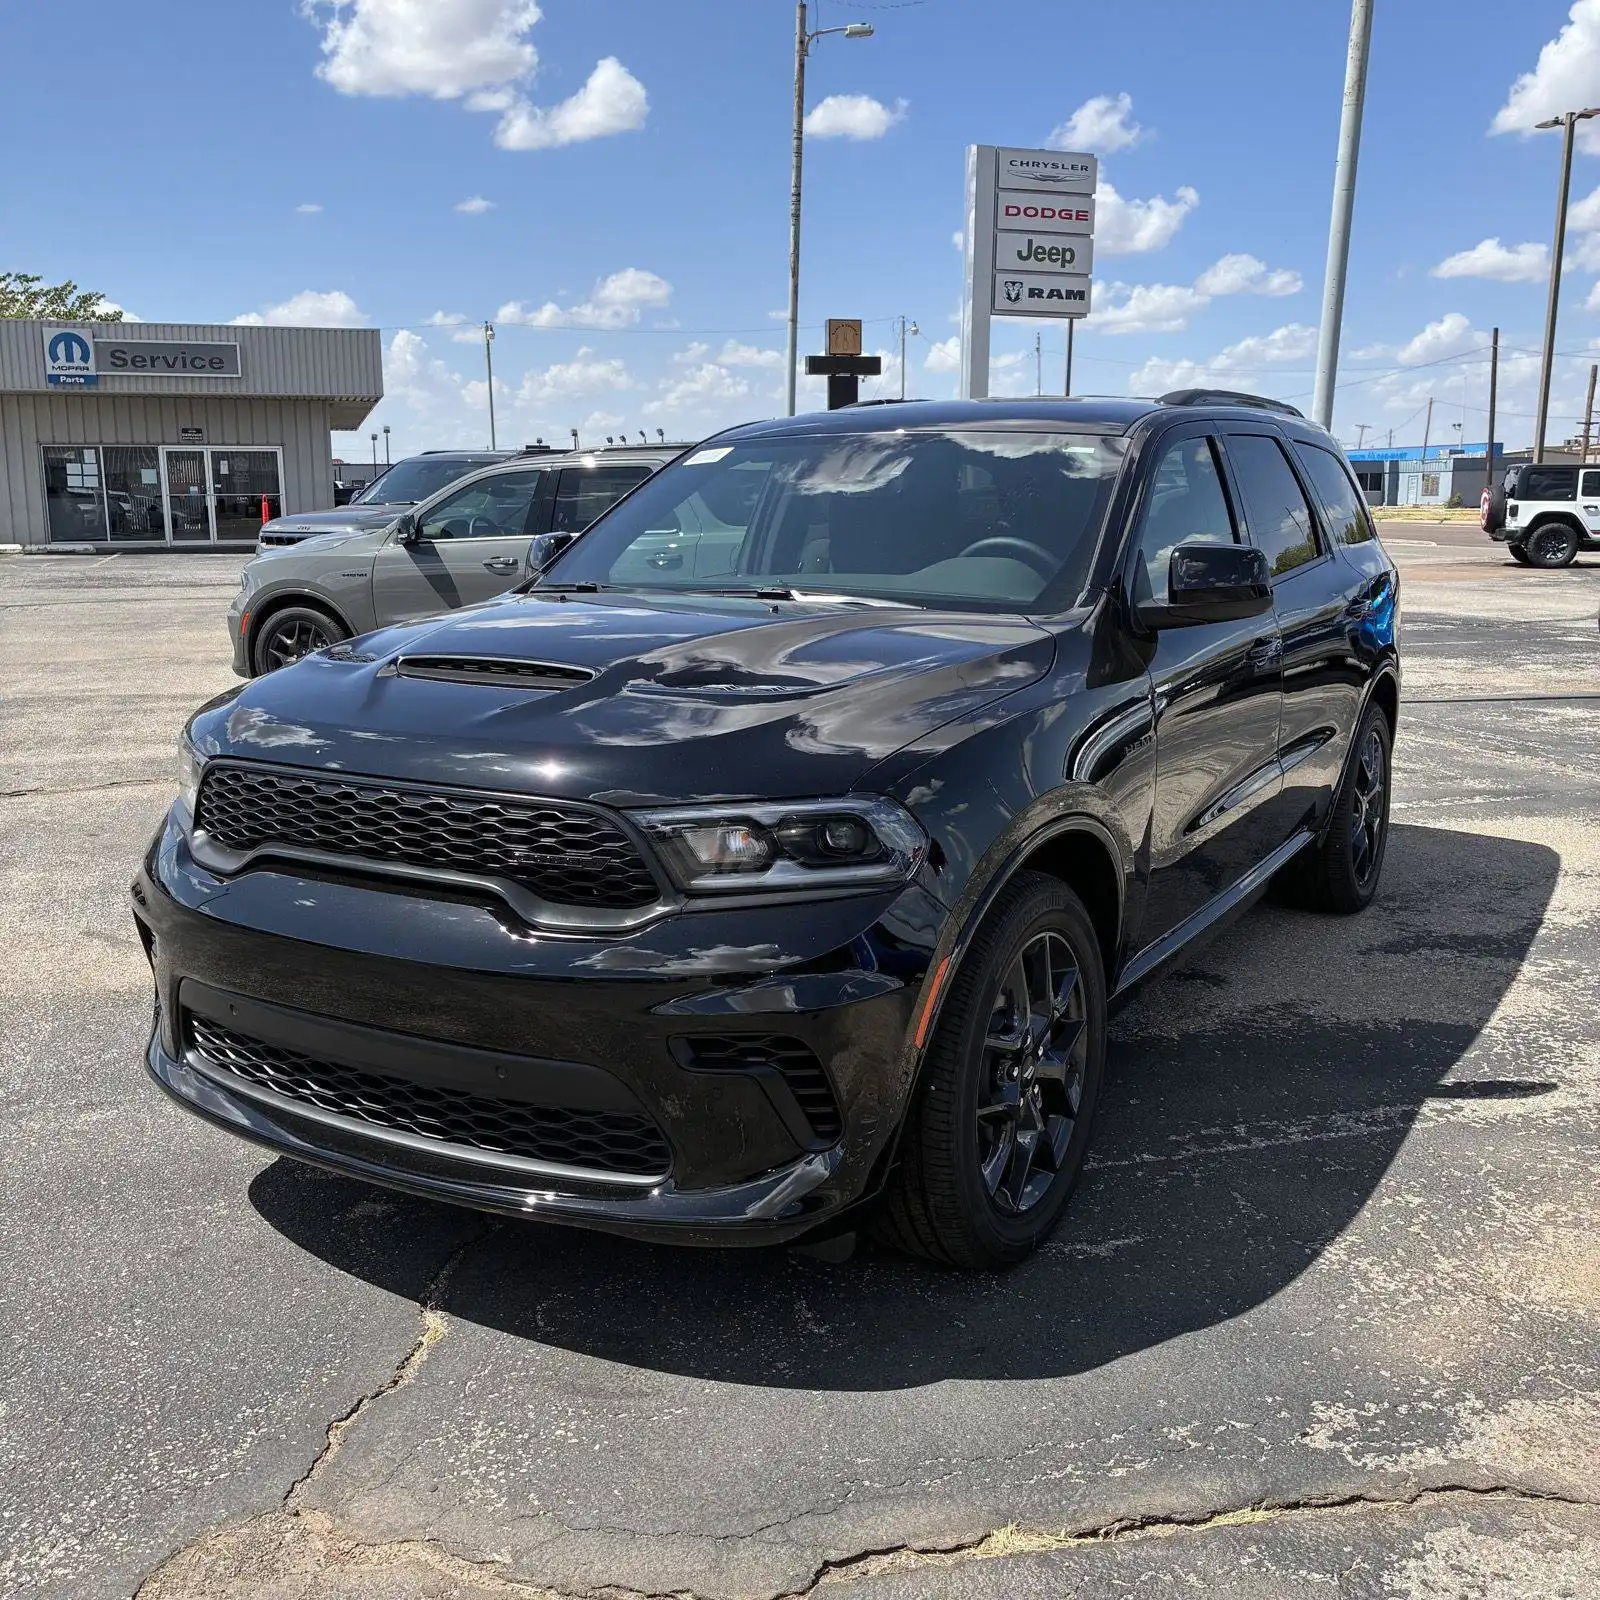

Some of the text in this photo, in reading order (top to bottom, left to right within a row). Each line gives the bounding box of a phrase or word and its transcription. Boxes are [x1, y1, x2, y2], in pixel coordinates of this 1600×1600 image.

[1009, 159, 1089, 171] CHRYSLER
[1004, 205, 1089, 221] DODGE
[1016, 238, 1075, 268] Jeep
[1027, 287, 1086, 301] RAM
[110, 348, 225, 370] Service
